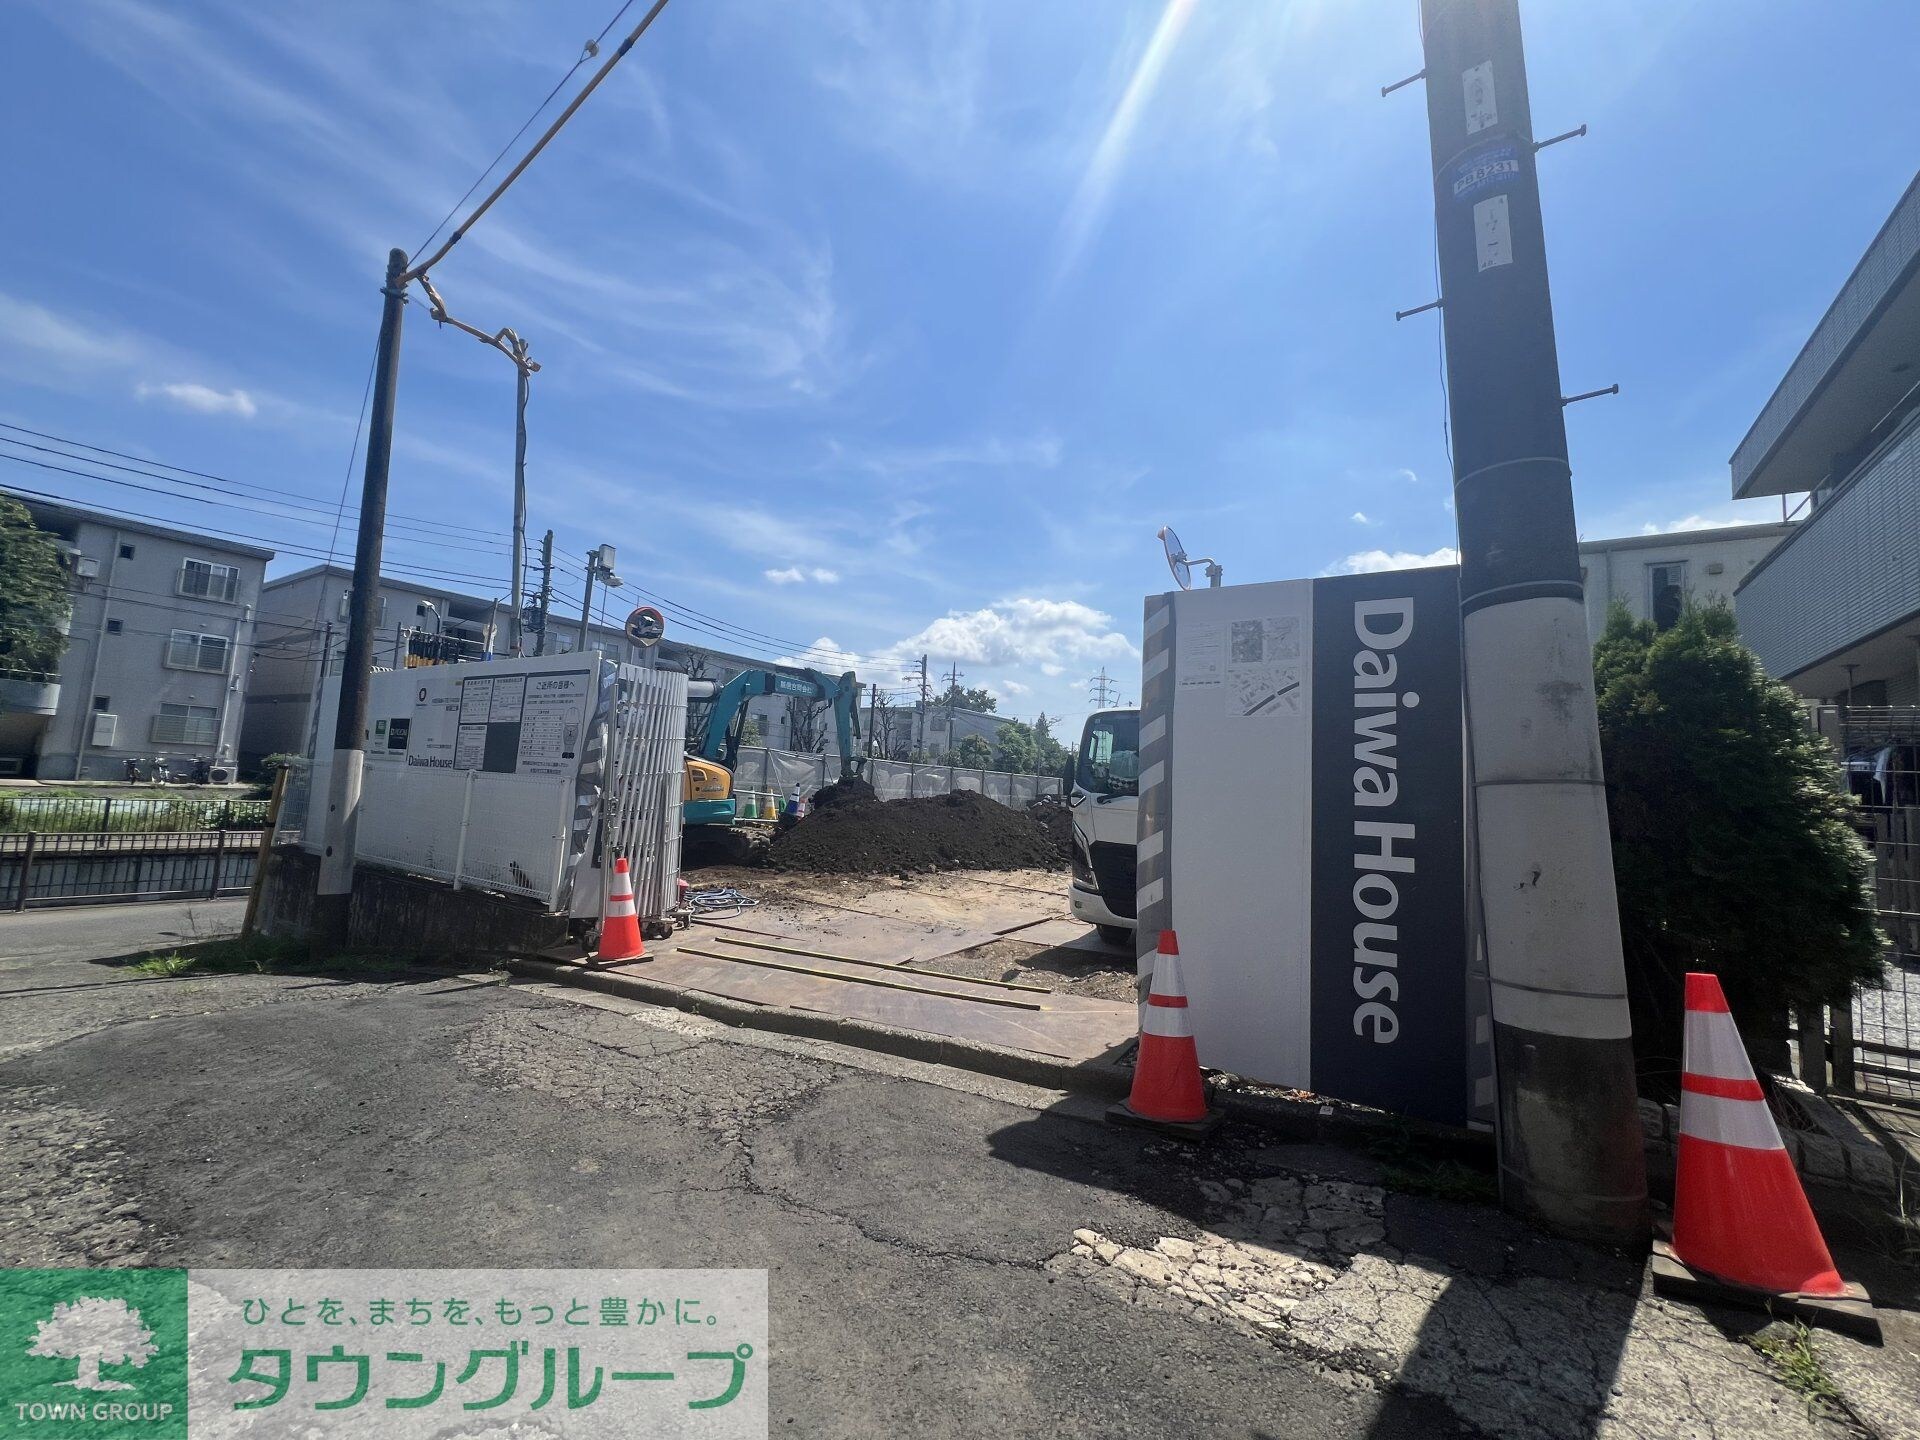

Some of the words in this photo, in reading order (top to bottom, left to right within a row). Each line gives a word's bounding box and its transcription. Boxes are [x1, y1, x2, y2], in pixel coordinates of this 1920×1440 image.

[408, 754, 429, 767] Daiwa
[429, 755, 453, 769] House
[1352, 597, 1419, 808] Daiwa
[1352, 820, 1416, 1045] House
